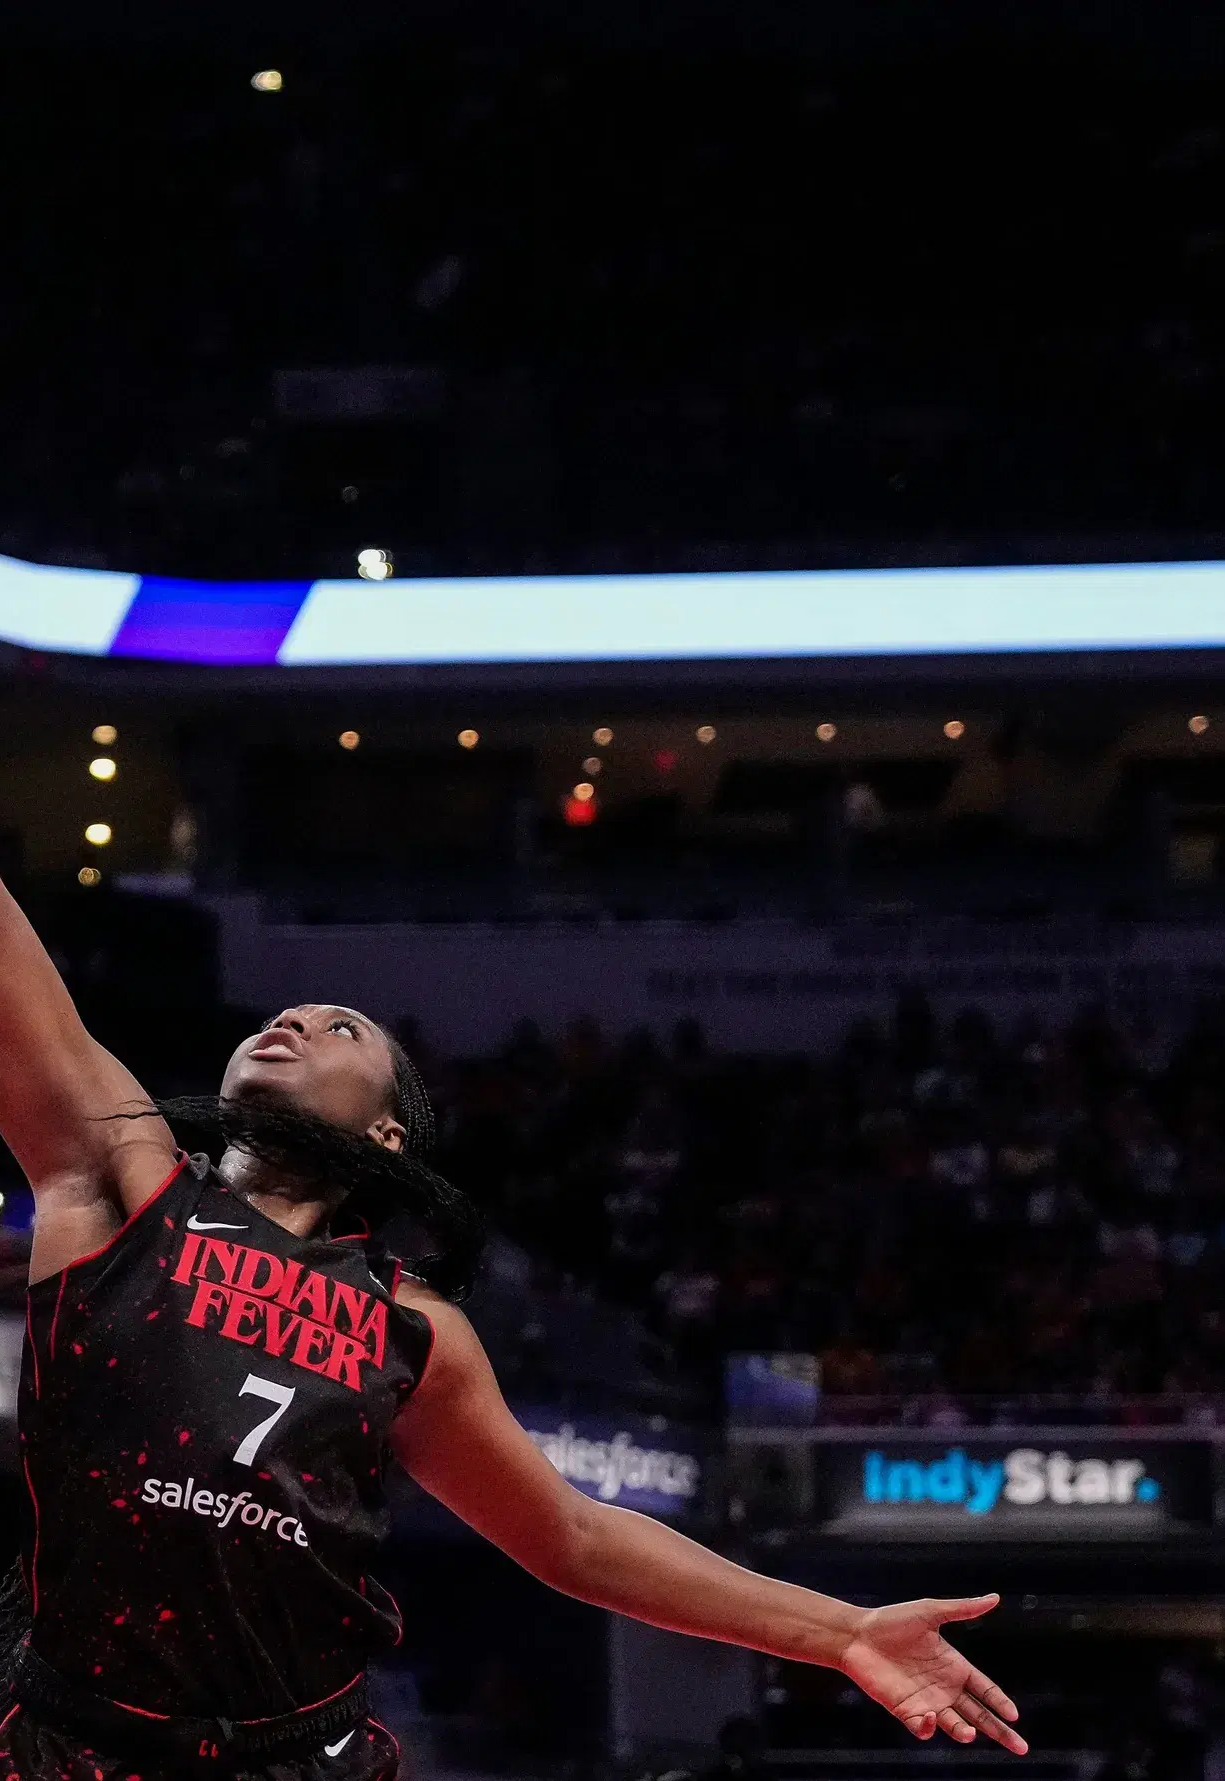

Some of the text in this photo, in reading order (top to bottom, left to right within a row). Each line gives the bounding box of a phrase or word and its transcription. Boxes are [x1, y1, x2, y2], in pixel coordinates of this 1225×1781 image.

[171, 1232, 389, 1370] INDIANA
[185, 1279, 363, 1393] FEVER
[232, 1373, 296, 1467] 7
